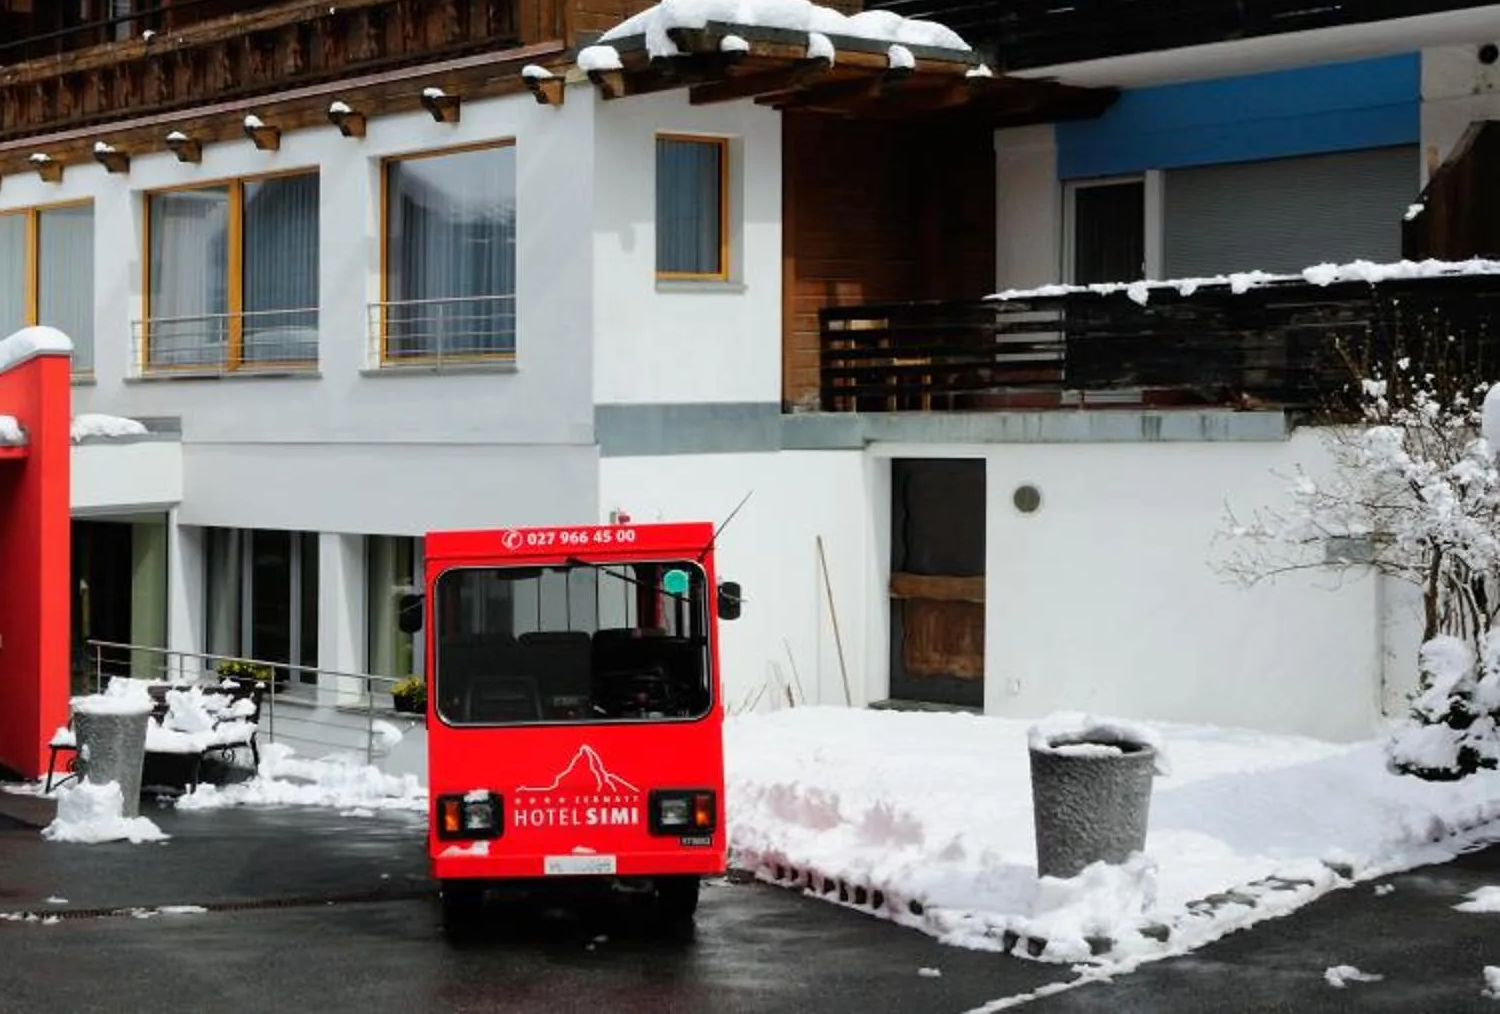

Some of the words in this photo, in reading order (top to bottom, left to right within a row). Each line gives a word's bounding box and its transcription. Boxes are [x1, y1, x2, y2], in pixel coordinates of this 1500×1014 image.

[527, 532, 555, 545] 027
[559, 531, 589, 545] 966
[593, 529, 613, 544] 45
[616, 529, 636, 543] 00
[514, 809, 581, 827] HOTEL
[586, 807, 639, 826] SIMI
